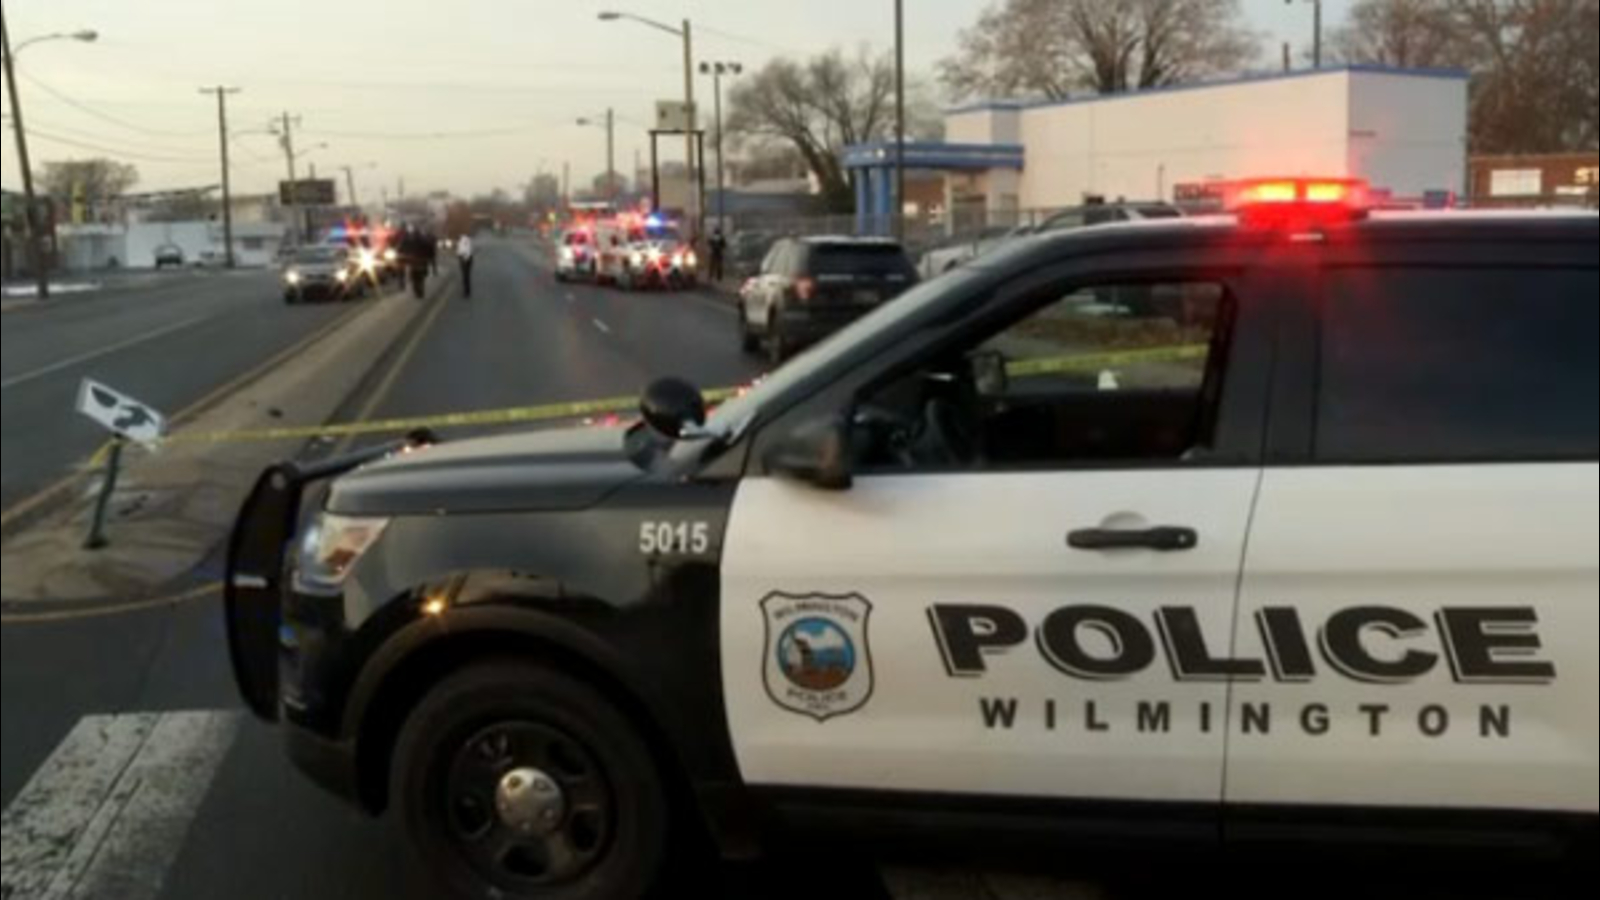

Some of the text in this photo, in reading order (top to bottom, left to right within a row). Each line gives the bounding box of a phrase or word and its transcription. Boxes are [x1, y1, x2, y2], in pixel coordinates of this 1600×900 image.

[640, 521, 708, 553] 5015
[925, 602, 1556, 684] POLICE
[979, 698, 1511, 738] WILMINGTON
